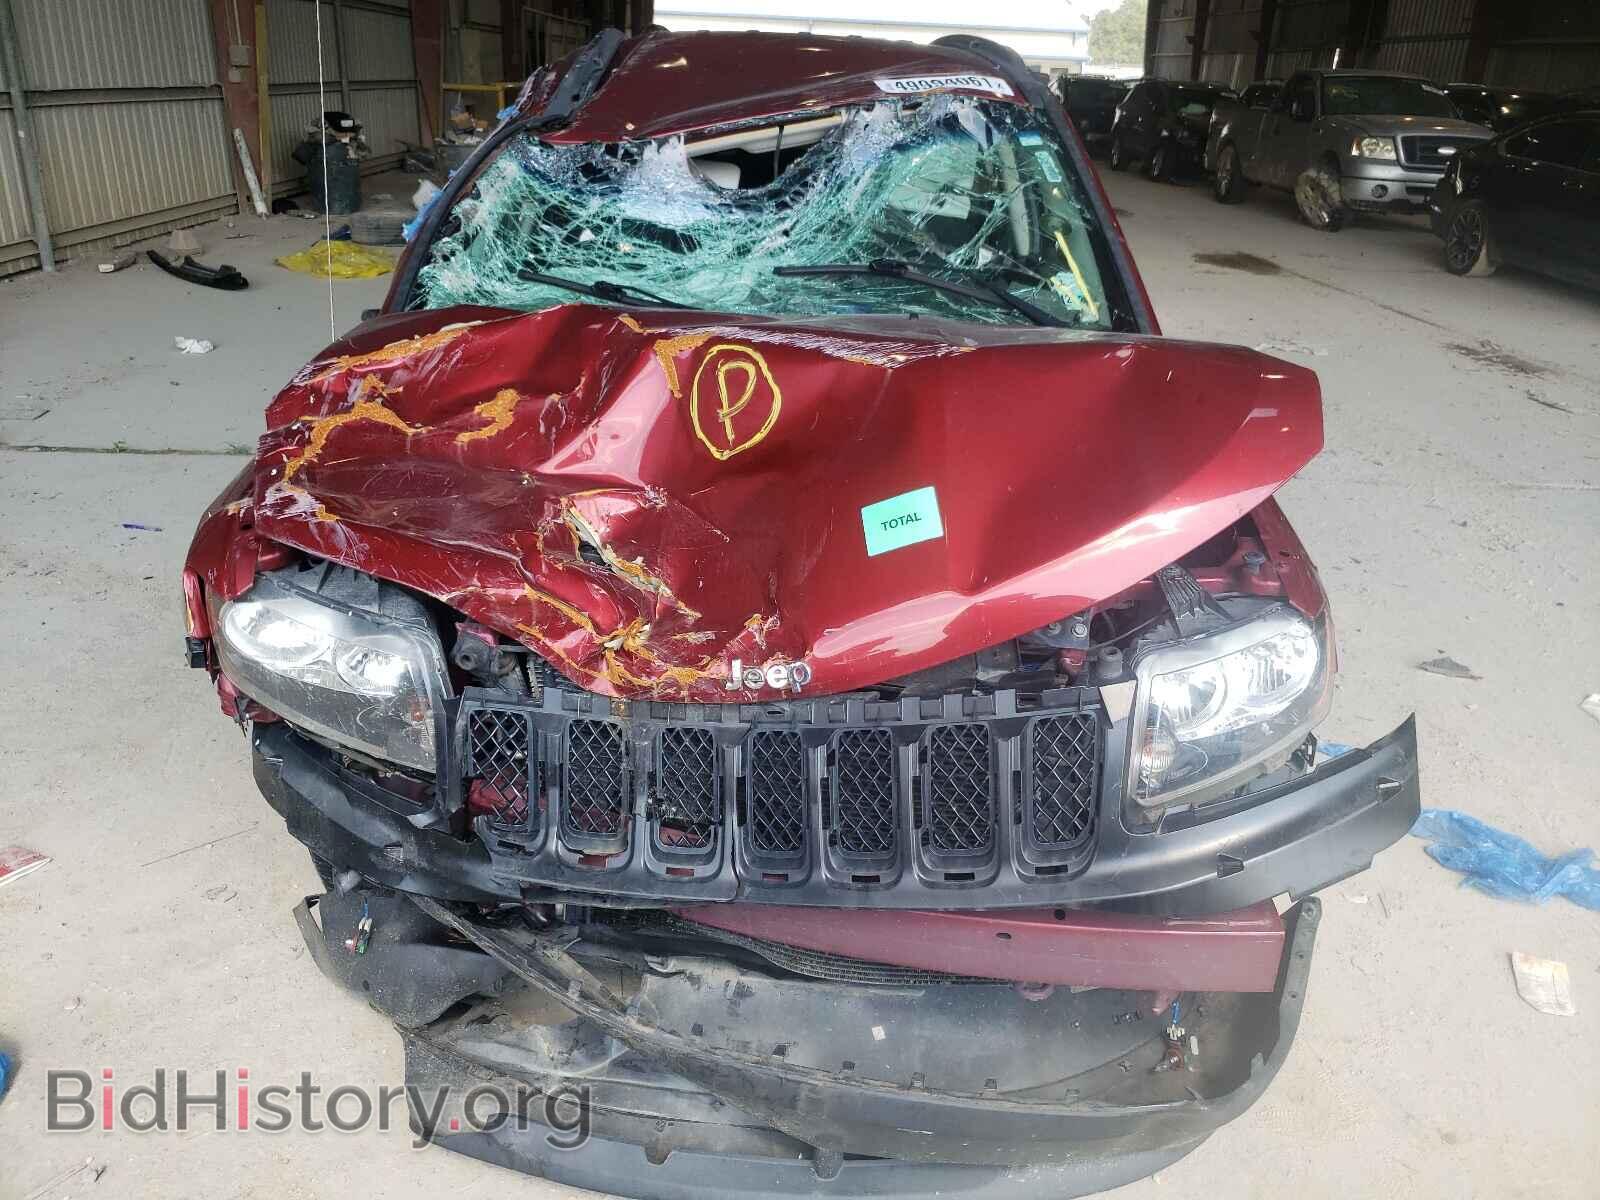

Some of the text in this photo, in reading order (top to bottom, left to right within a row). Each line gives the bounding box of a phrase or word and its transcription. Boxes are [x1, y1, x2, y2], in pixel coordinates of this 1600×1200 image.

[715, 359, 757, 446] P
[881, 512, 922, 531] TOTAL
[725, 658, 811, 693] Jeep
